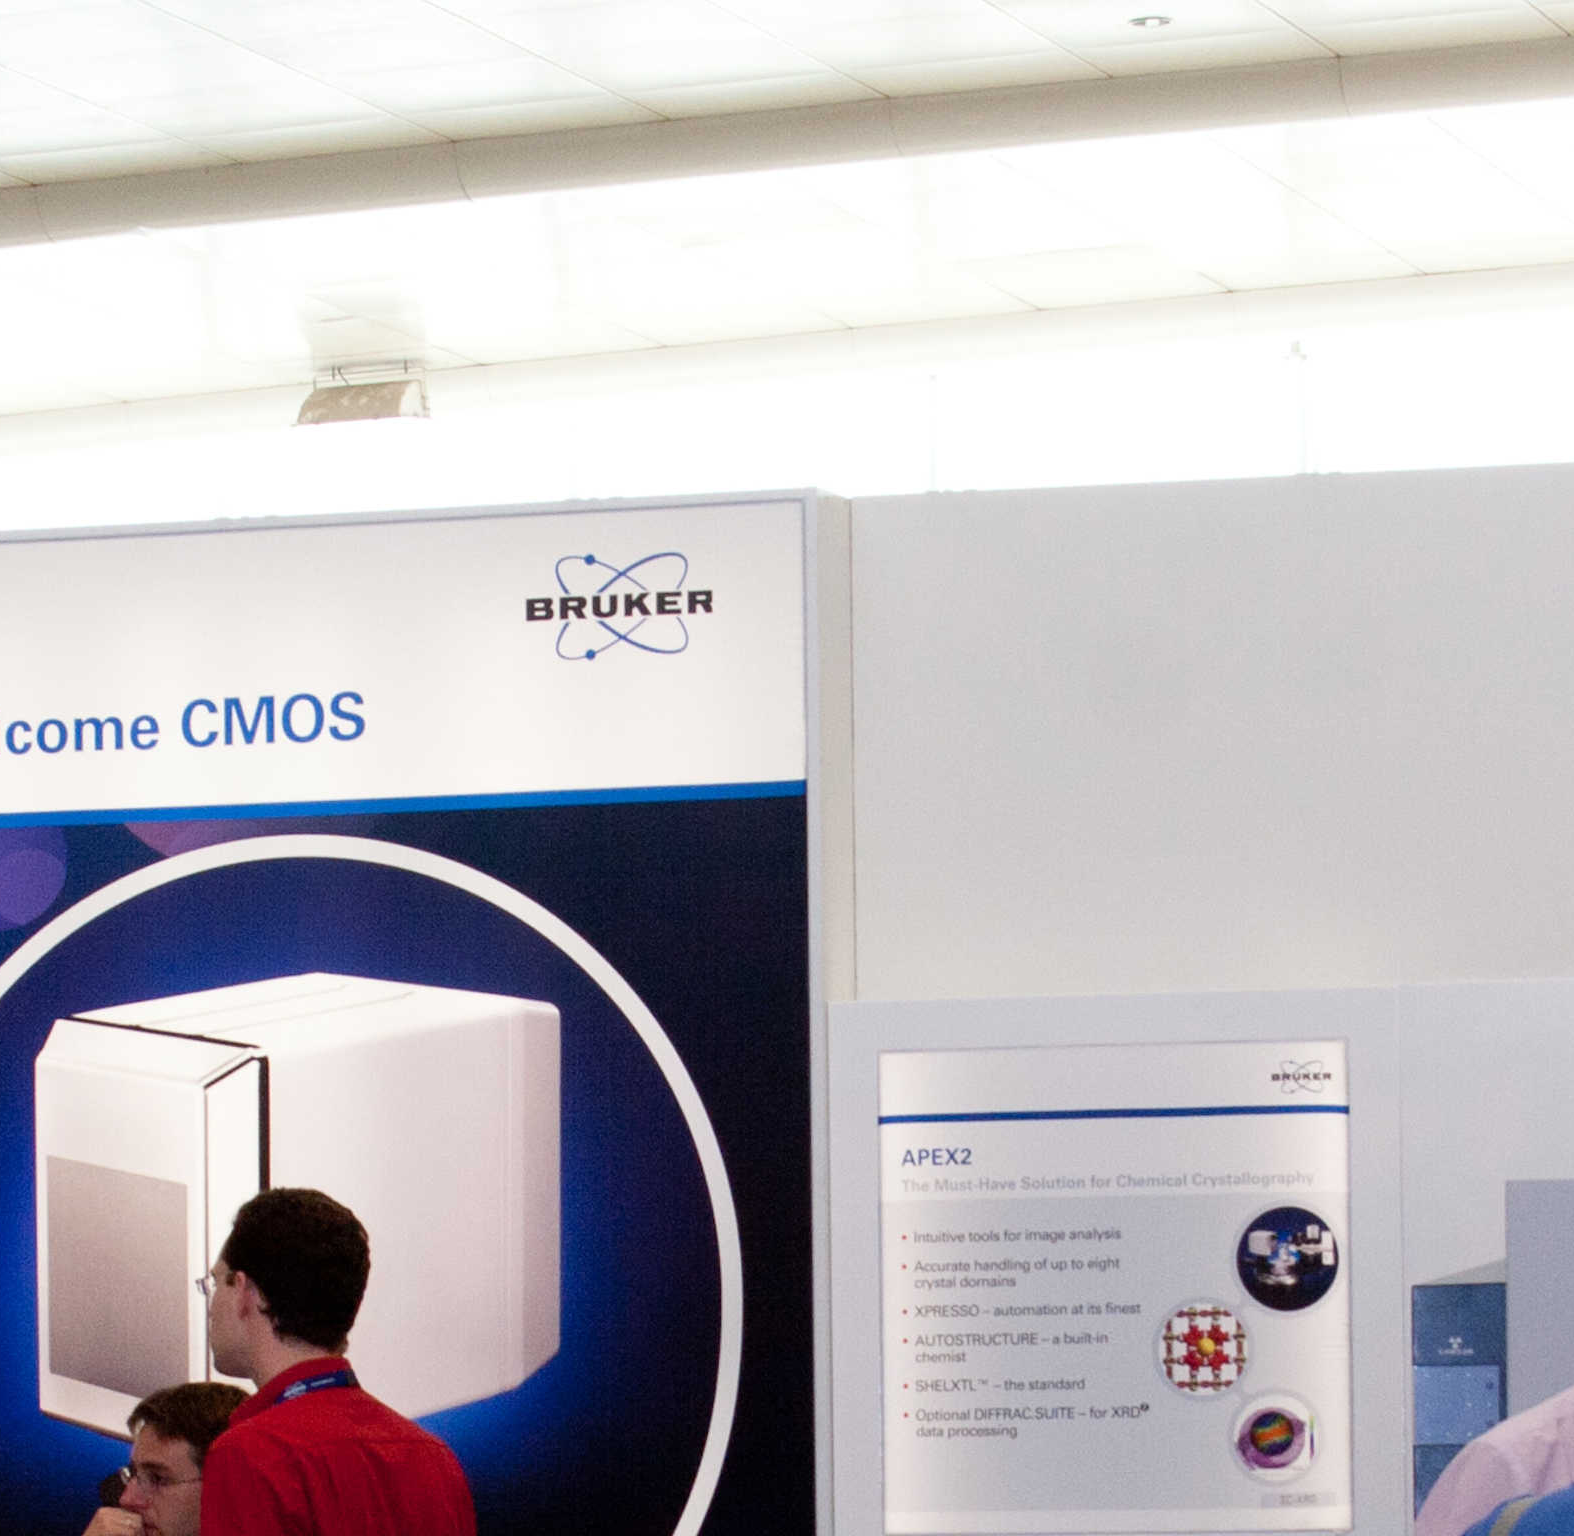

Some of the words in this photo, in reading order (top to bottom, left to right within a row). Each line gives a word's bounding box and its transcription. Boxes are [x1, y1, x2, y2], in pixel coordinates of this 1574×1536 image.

[526, 589, 713, 622] BRUKER
[181, 691, 366, 748] CMOS
[1271, 1072, 1332, 1082] BRUKER
[901, 1147, 973, 1168] APEX2
[901, 1178, 930, 1193] The
[934, 1176, 1016, 1193] Must-Have
[1020, 1175, 1086, 1192] Solution
[1089, 1174, 1112, 1190] for
[1115, 1173, 1188, 1189] Chemical
[1191, 1170, 1314, 1191] Crystallography
[913, 1231, 966, 1244] Intuitive
[968, 1230, 1000, 1243] tools
[1004, 1230, 1022, 1243] for
[1025, 1229, 1066, 1244] image
[1069, 1227, 1122, 1242] analysis
[914, 1260, 971, 1273] Accurate
[974, 1259, 1031, 1274] handling
[1034, 1258, 1047, 1271] of
[1050, 1259, 1068, 1273] up
[1071, 1258, 1084, 1271] to
[1087, 1257, 1120, 1273] eight
[914, 1276, 957, 1290] crystal
[959, 1275, 1017, 1289] domains
[914, 1304, 980, 1318] XPRESSO
[993, 1303, 1068, 1318] automation
[1071, 1304, 1084, 1316] at
[1087, 1303, 1103, 1316] its
[1105, 1301, 1142, 1316] finest
[915, 1332, 1039, 1348] AUTOSTRUCTURE
[1052, 1335, 1060, 1345] a
[1063, 1331, 1109, 1345] built-in
[915, 1351, 967, 1364] chemist
[1004, 1379, 1025, 1391] the
[1028, 1378, 1086, 1391] standard
[915, 1408, 971, 1423] Optional
[1089, 1406, 1108, 1419] for
[916, 1425, 944, 1438] data
[947, 1424, 1018, 1439] processing
